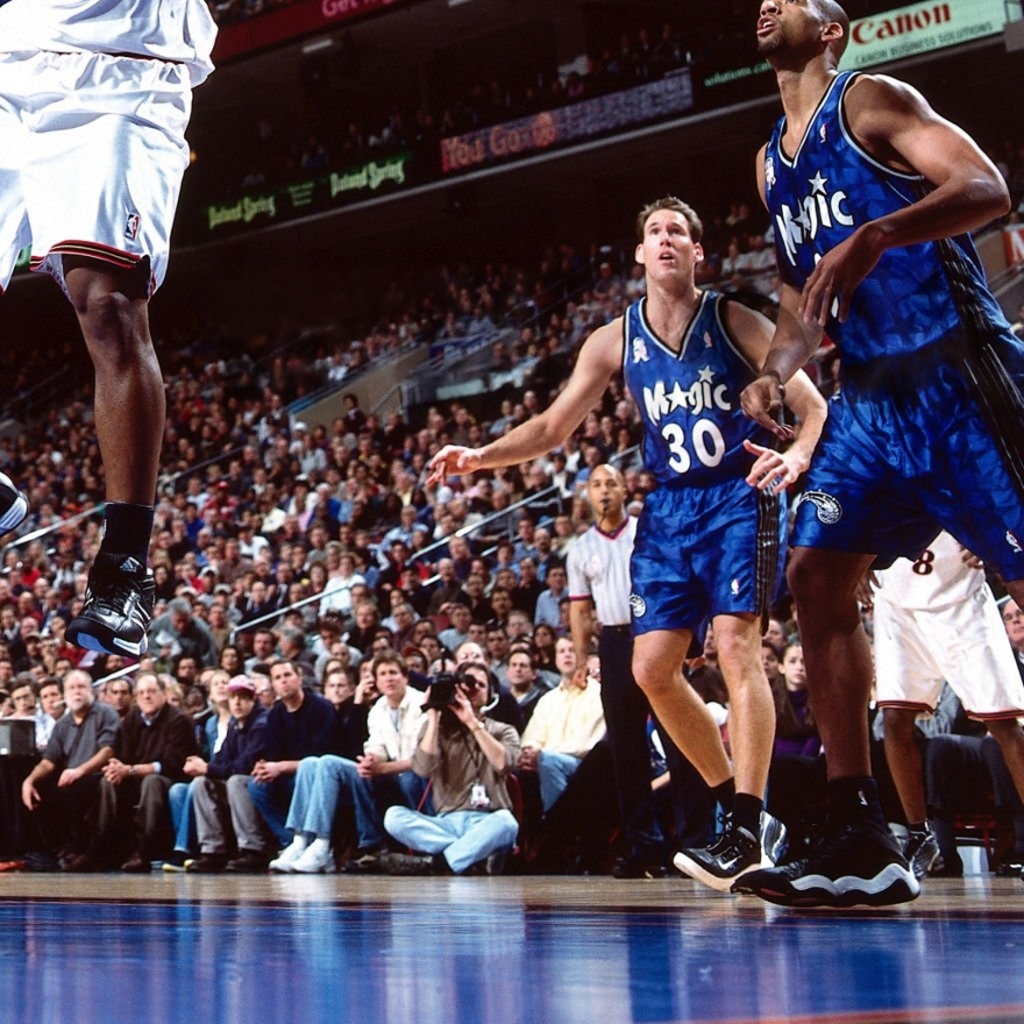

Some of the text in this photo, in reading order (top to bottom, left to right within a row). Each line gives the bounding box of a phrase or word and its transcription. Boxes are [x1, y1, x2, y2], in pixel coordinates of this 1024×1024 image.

[851, 3, 951, 45] Canon
[661, 418, 726, 474] 30
[912, 549, 935, 576] 8
